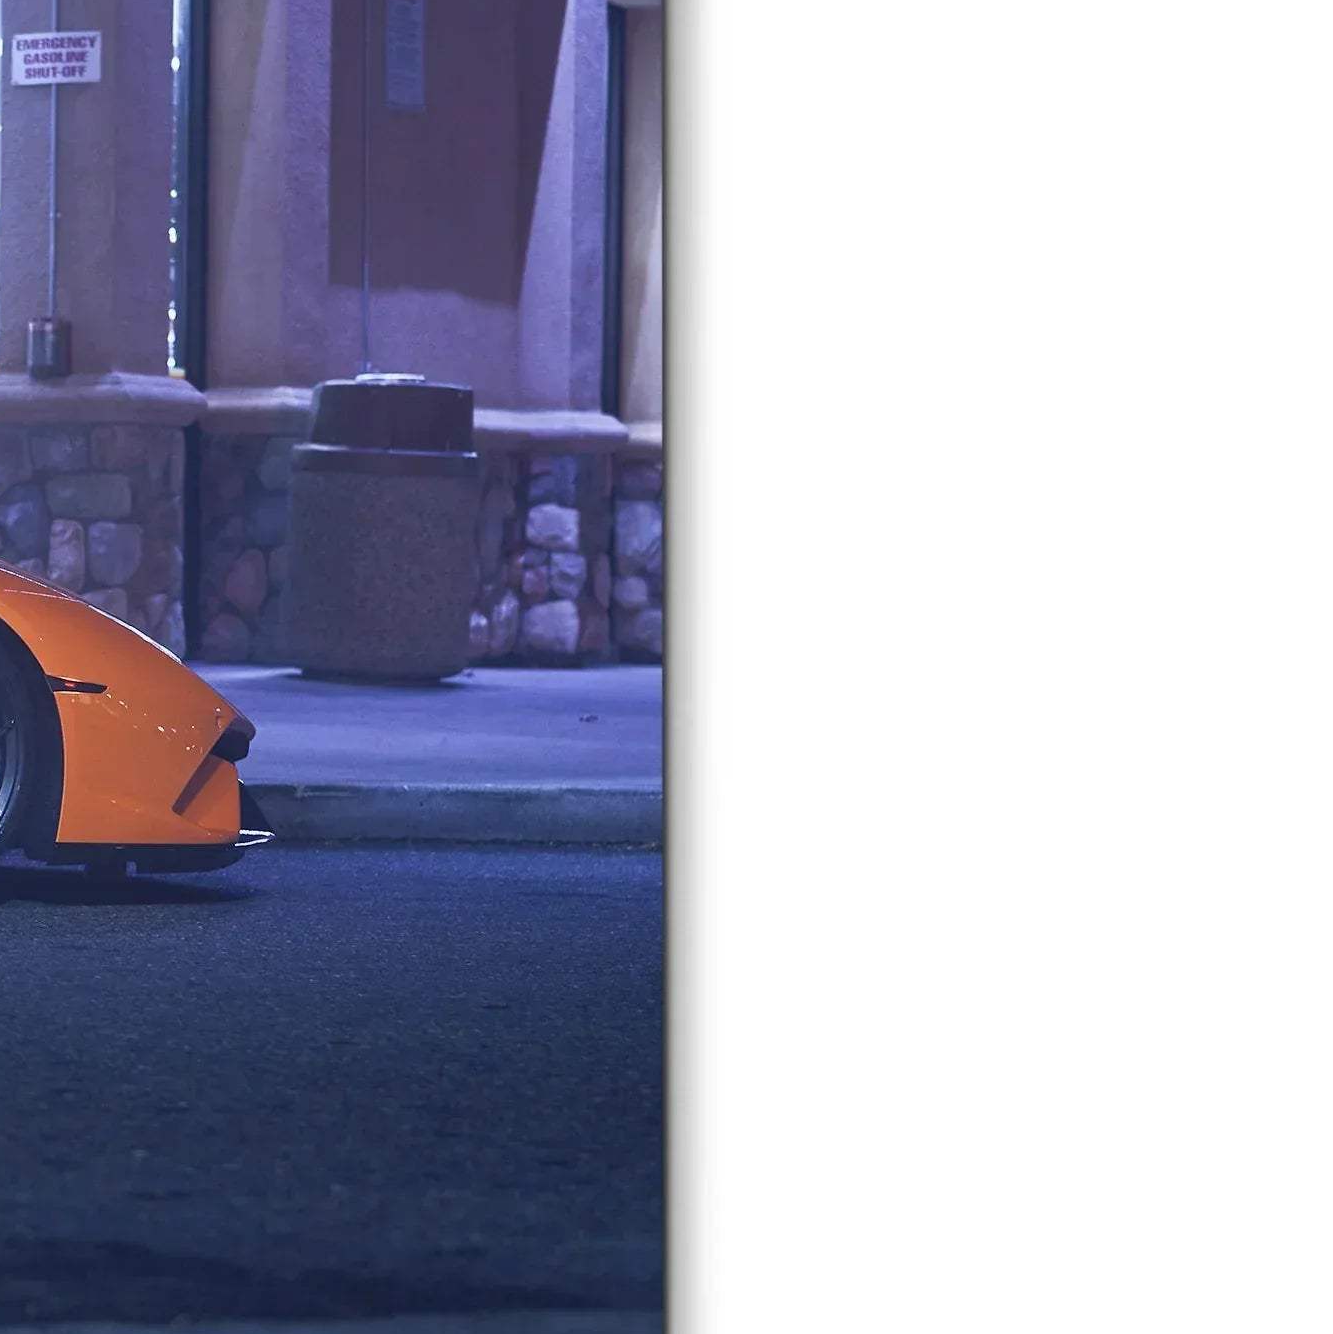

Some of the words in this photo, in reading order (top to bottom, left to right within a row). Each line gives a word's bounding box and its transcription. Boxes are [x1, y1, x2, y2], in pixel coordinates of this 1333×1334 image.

[16, 36, 96, 51] EMERGENCY
[23, 52, 87, 65] GASOLINE
[25, 66, 85, 79] SHUT-OFF
